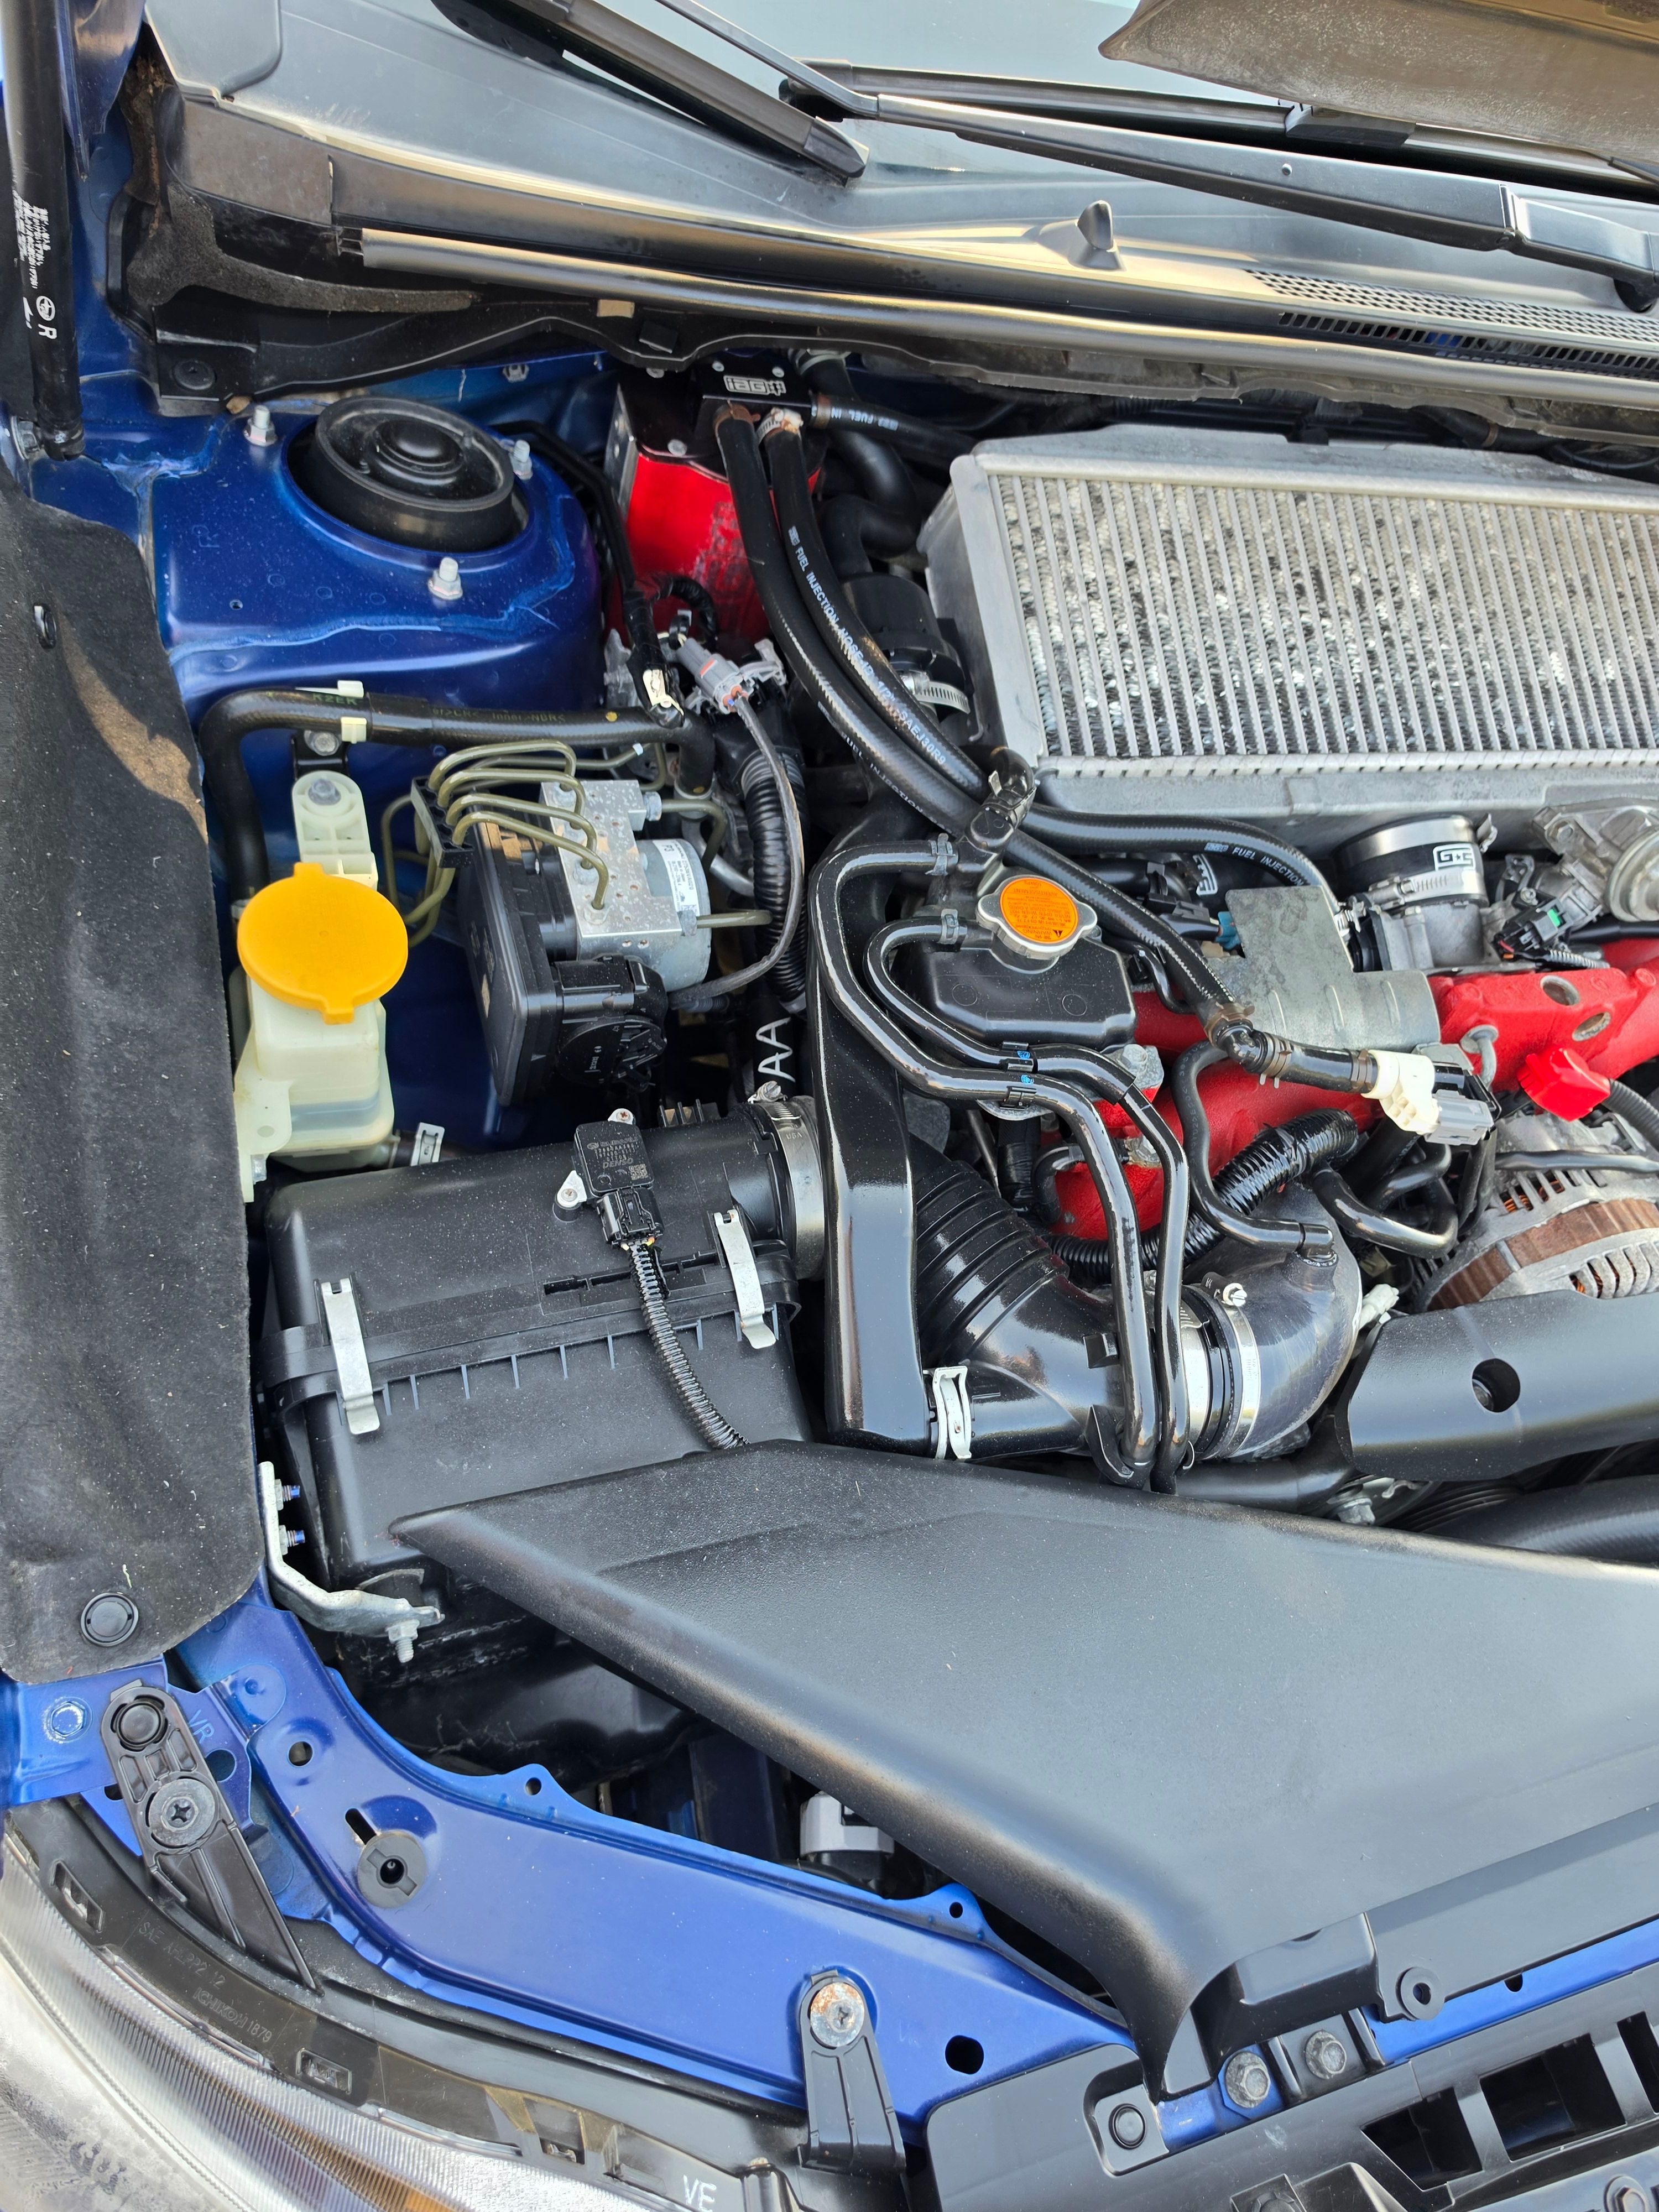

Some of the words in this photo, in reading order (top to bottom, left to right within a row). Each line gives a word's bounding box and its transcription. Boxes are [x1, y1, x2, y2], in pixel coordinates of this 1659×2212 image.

[795, 546, 809, 572] FUEL
[806, 571, 839, 623] INJECTION
[1232, 847, 1257, 860] FUEL
[1260, 856, 1304, 886] INJECTION
[603, 1158, 634, 1168] DENSO
[139, 1922, 165, 1945] SAE
[192, 1987, 248, 2029] ICHIKOH
